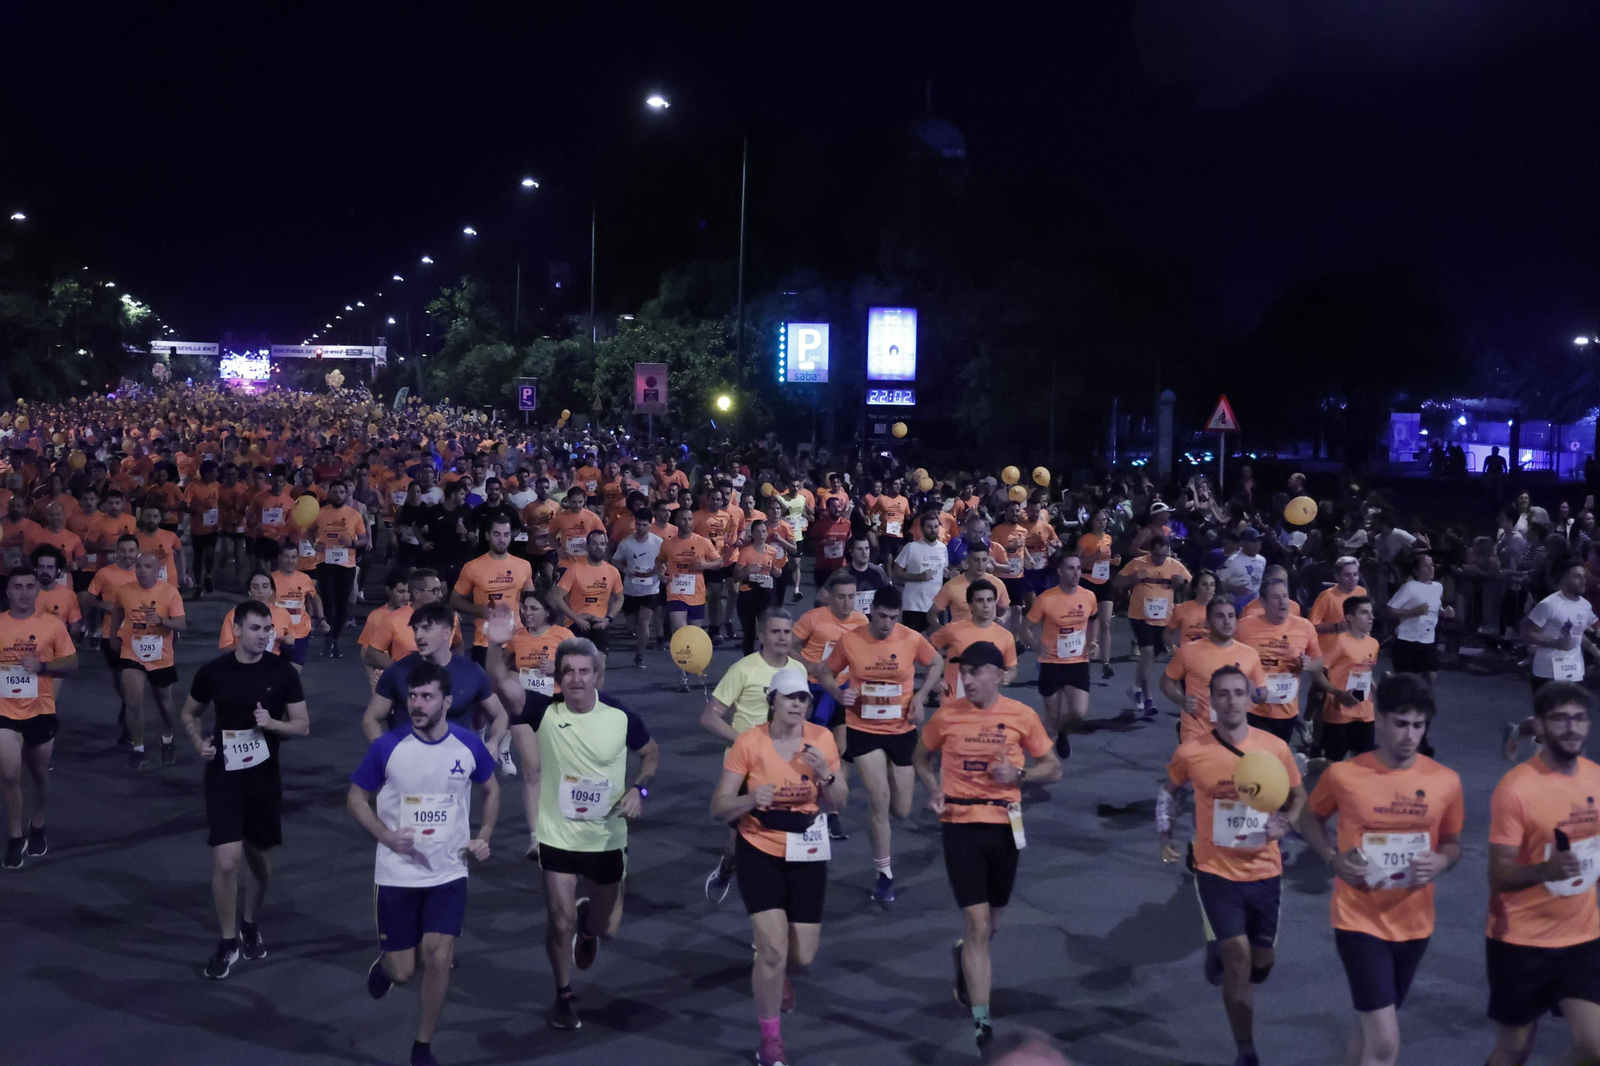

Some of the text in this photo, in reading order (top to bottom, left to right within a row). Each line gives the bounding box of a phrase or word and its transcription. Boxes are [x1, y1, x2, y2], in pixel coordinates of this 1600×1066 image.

[798, 329, 821, 361] P
[794, 371, 818, 381] saba
[522, 388, 532, 400] P
[869, 390, 912, 403] 22:02
[676, 580, 691, 588] 20261
[140, 644, 156, 652] 5283
[1064, 639, 1082, 649] 13116
[6, 675, 31, 685] 16344
[527, 678, 545, 688] 7484
[1275, 683, 1292, 692] 3887
[231, 739, 261, 755] 11915
[570, 788, 602, 803] 10943
[413, 810, 448, 823] 10955
[1227, 816, 1259, 829] 16700
